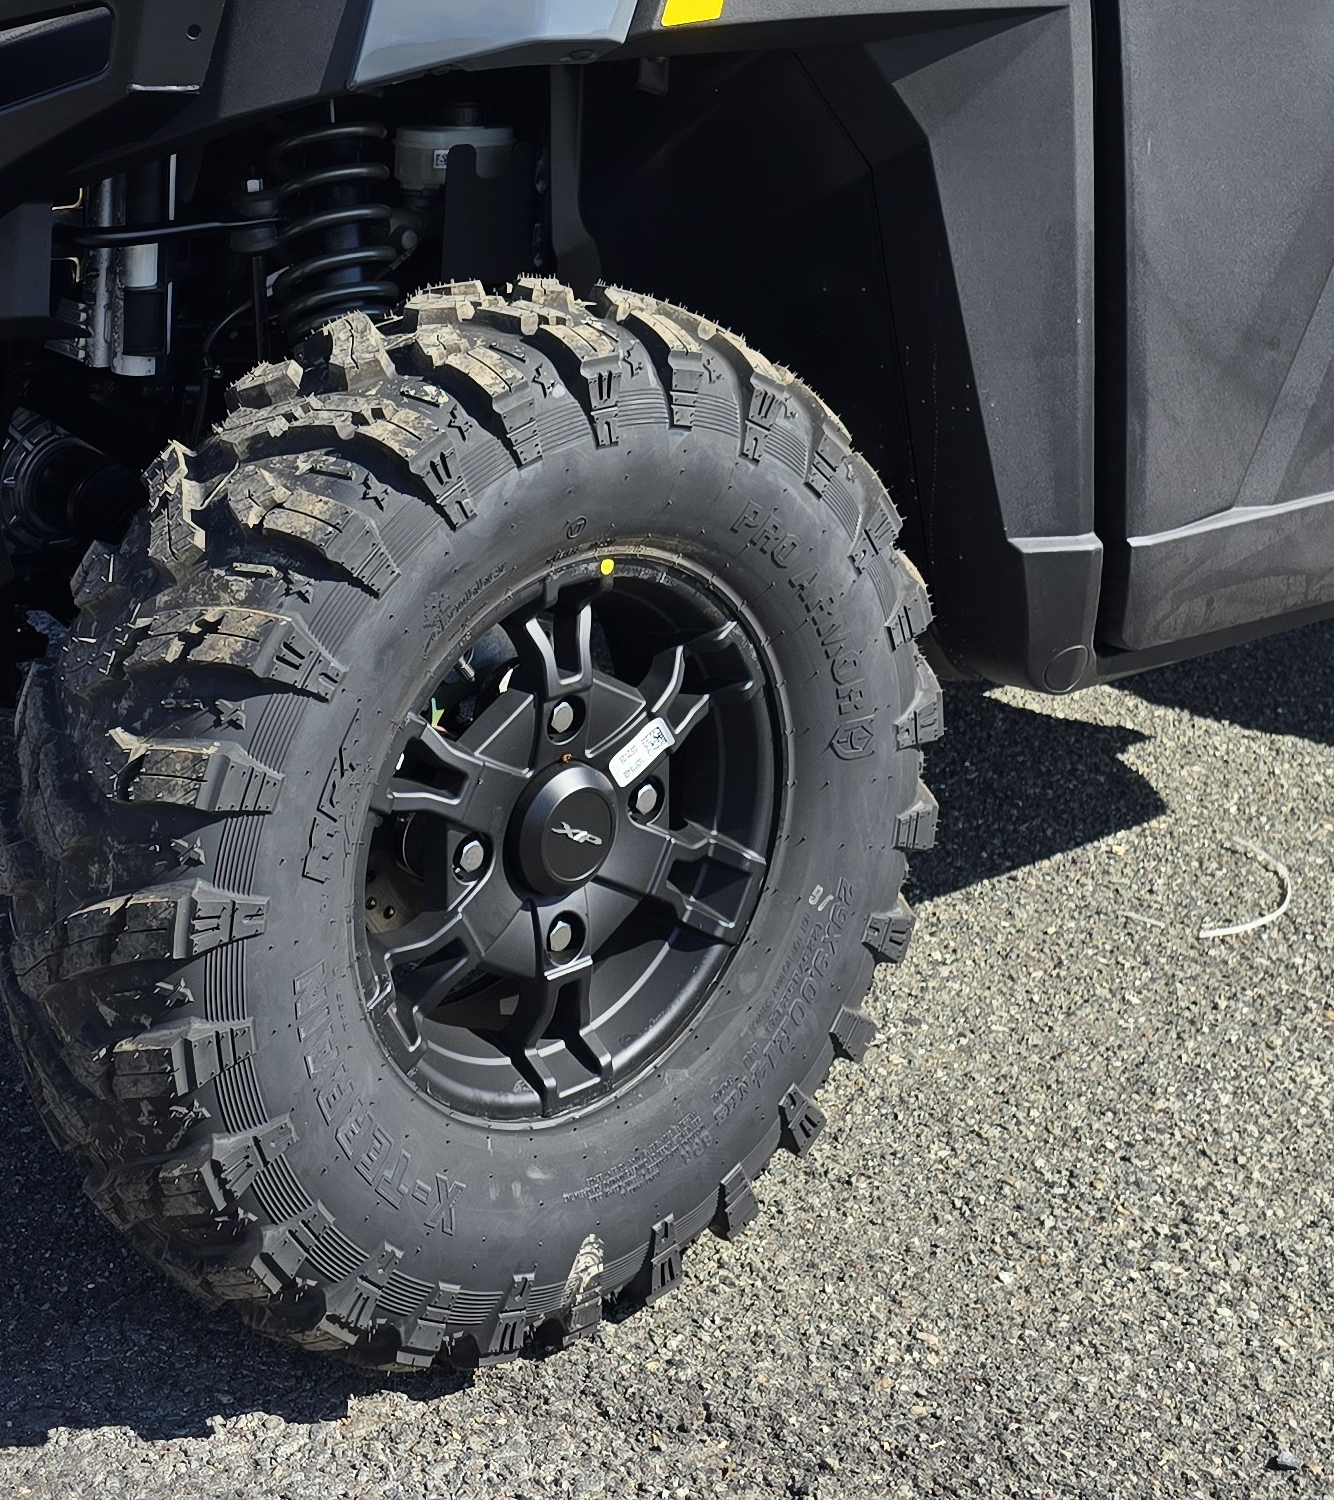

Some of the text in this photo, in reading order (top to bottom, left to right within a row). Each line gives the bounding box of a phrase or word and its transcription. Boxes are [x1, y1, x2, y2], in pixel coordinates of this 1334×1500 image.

[729, 500, 866, 716] PRO ARMOR
[551, 821, 603, 845] XP
[292, 958, 467, 1237] X-TERRAIN
